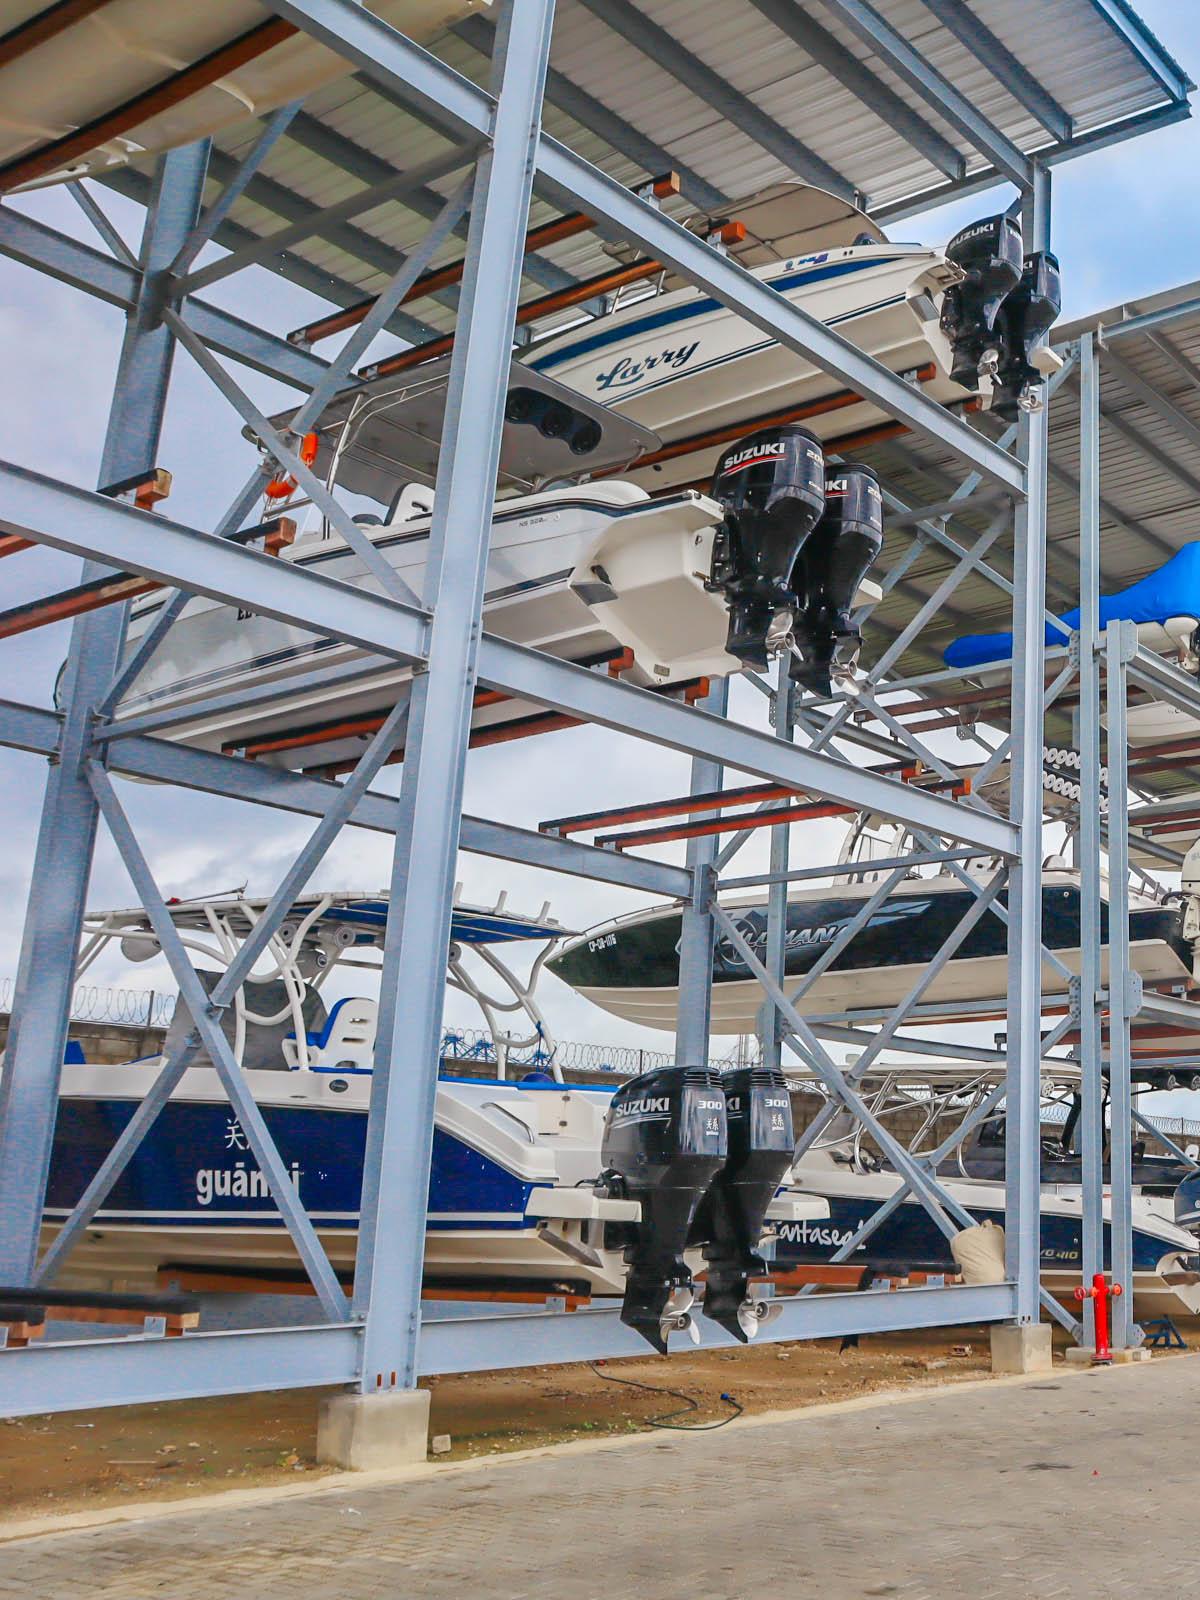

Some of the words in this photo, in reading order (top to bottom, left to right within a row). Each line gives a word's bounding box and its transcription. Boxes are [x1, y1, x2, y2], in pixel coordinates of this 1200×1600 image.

[595, 341, 700, 391] Larry
[724, 442, 785, 470] SUZUKI
[616, 1097, 670, 1118] SUZUKI
[697, 1100, 722, 1110] 300
[764, 1098, 788, 1108] 300
[196, 1162, 300, 1205] guāni
